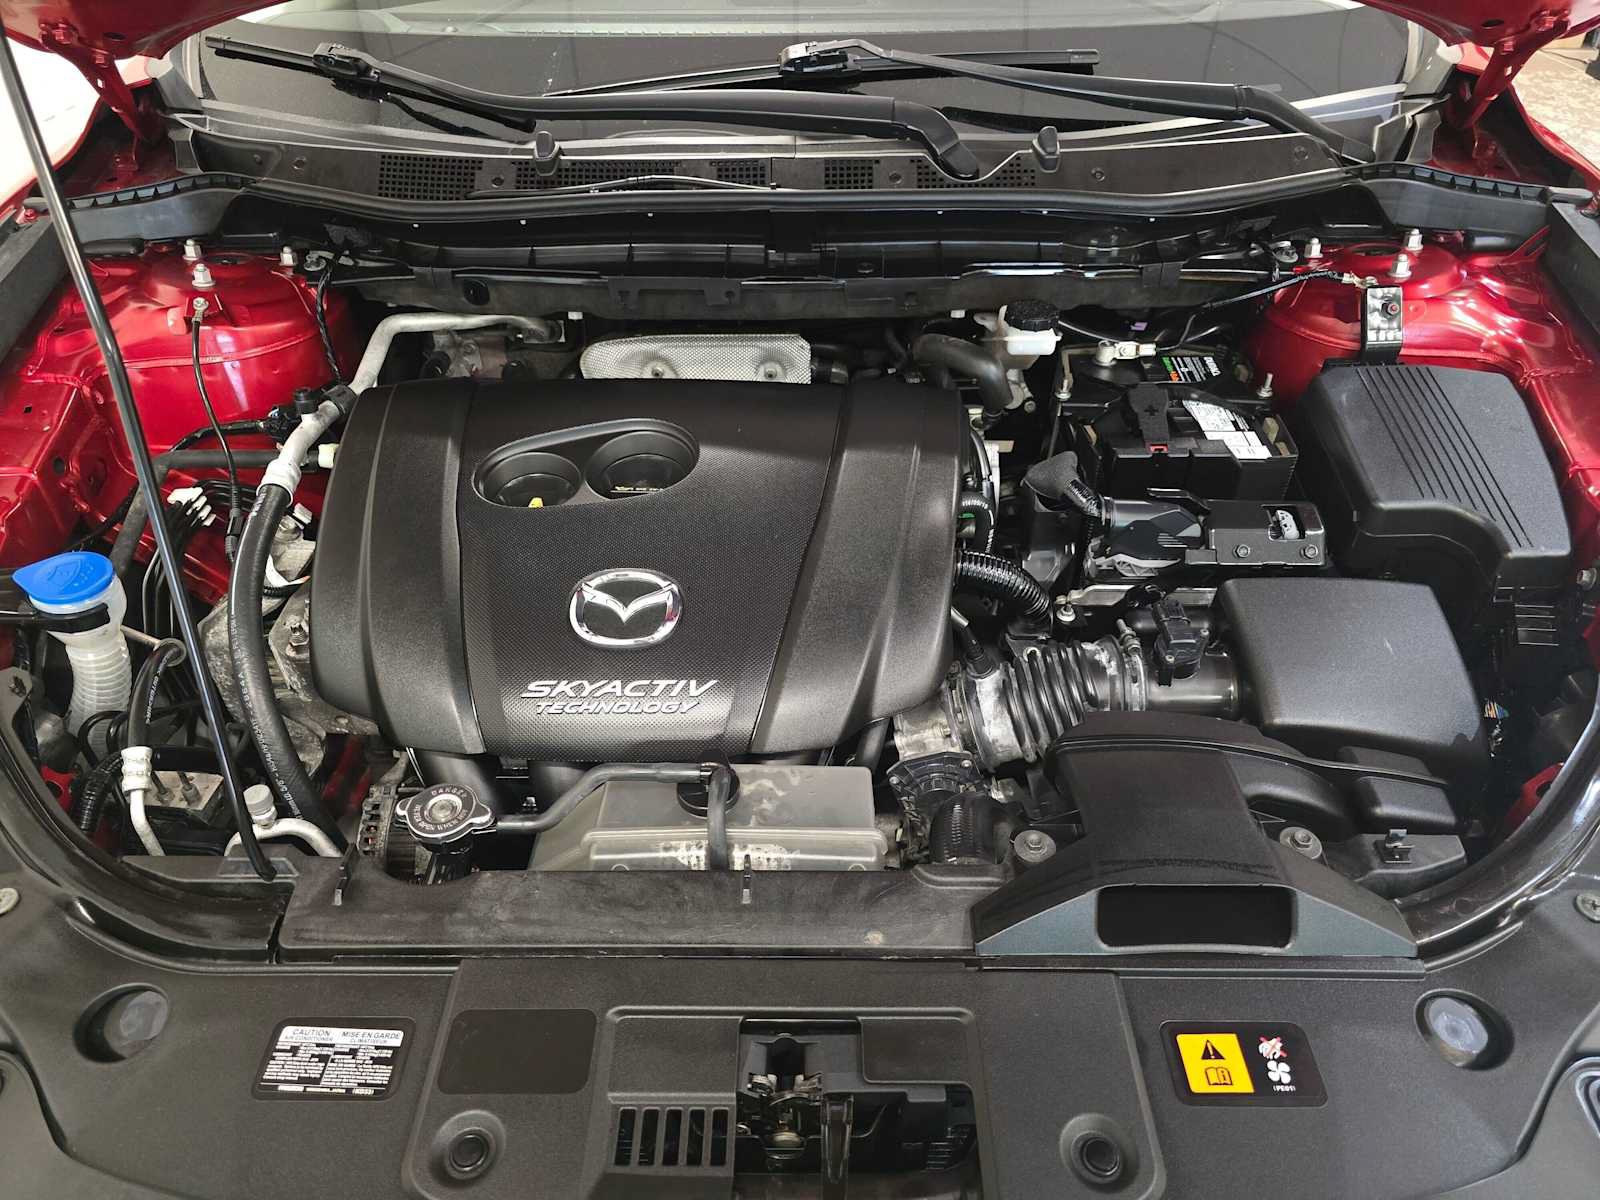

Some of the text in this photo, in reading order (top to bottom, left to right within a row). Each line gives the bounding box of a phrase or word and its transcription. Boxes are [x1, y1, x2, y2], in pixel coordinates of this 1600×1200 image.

[521, 680, 719, 698] SKYACTIV
[536, 700, 701, 714] TECHNOLOGY
[292, 1028, 330, 1036] CAUTION
